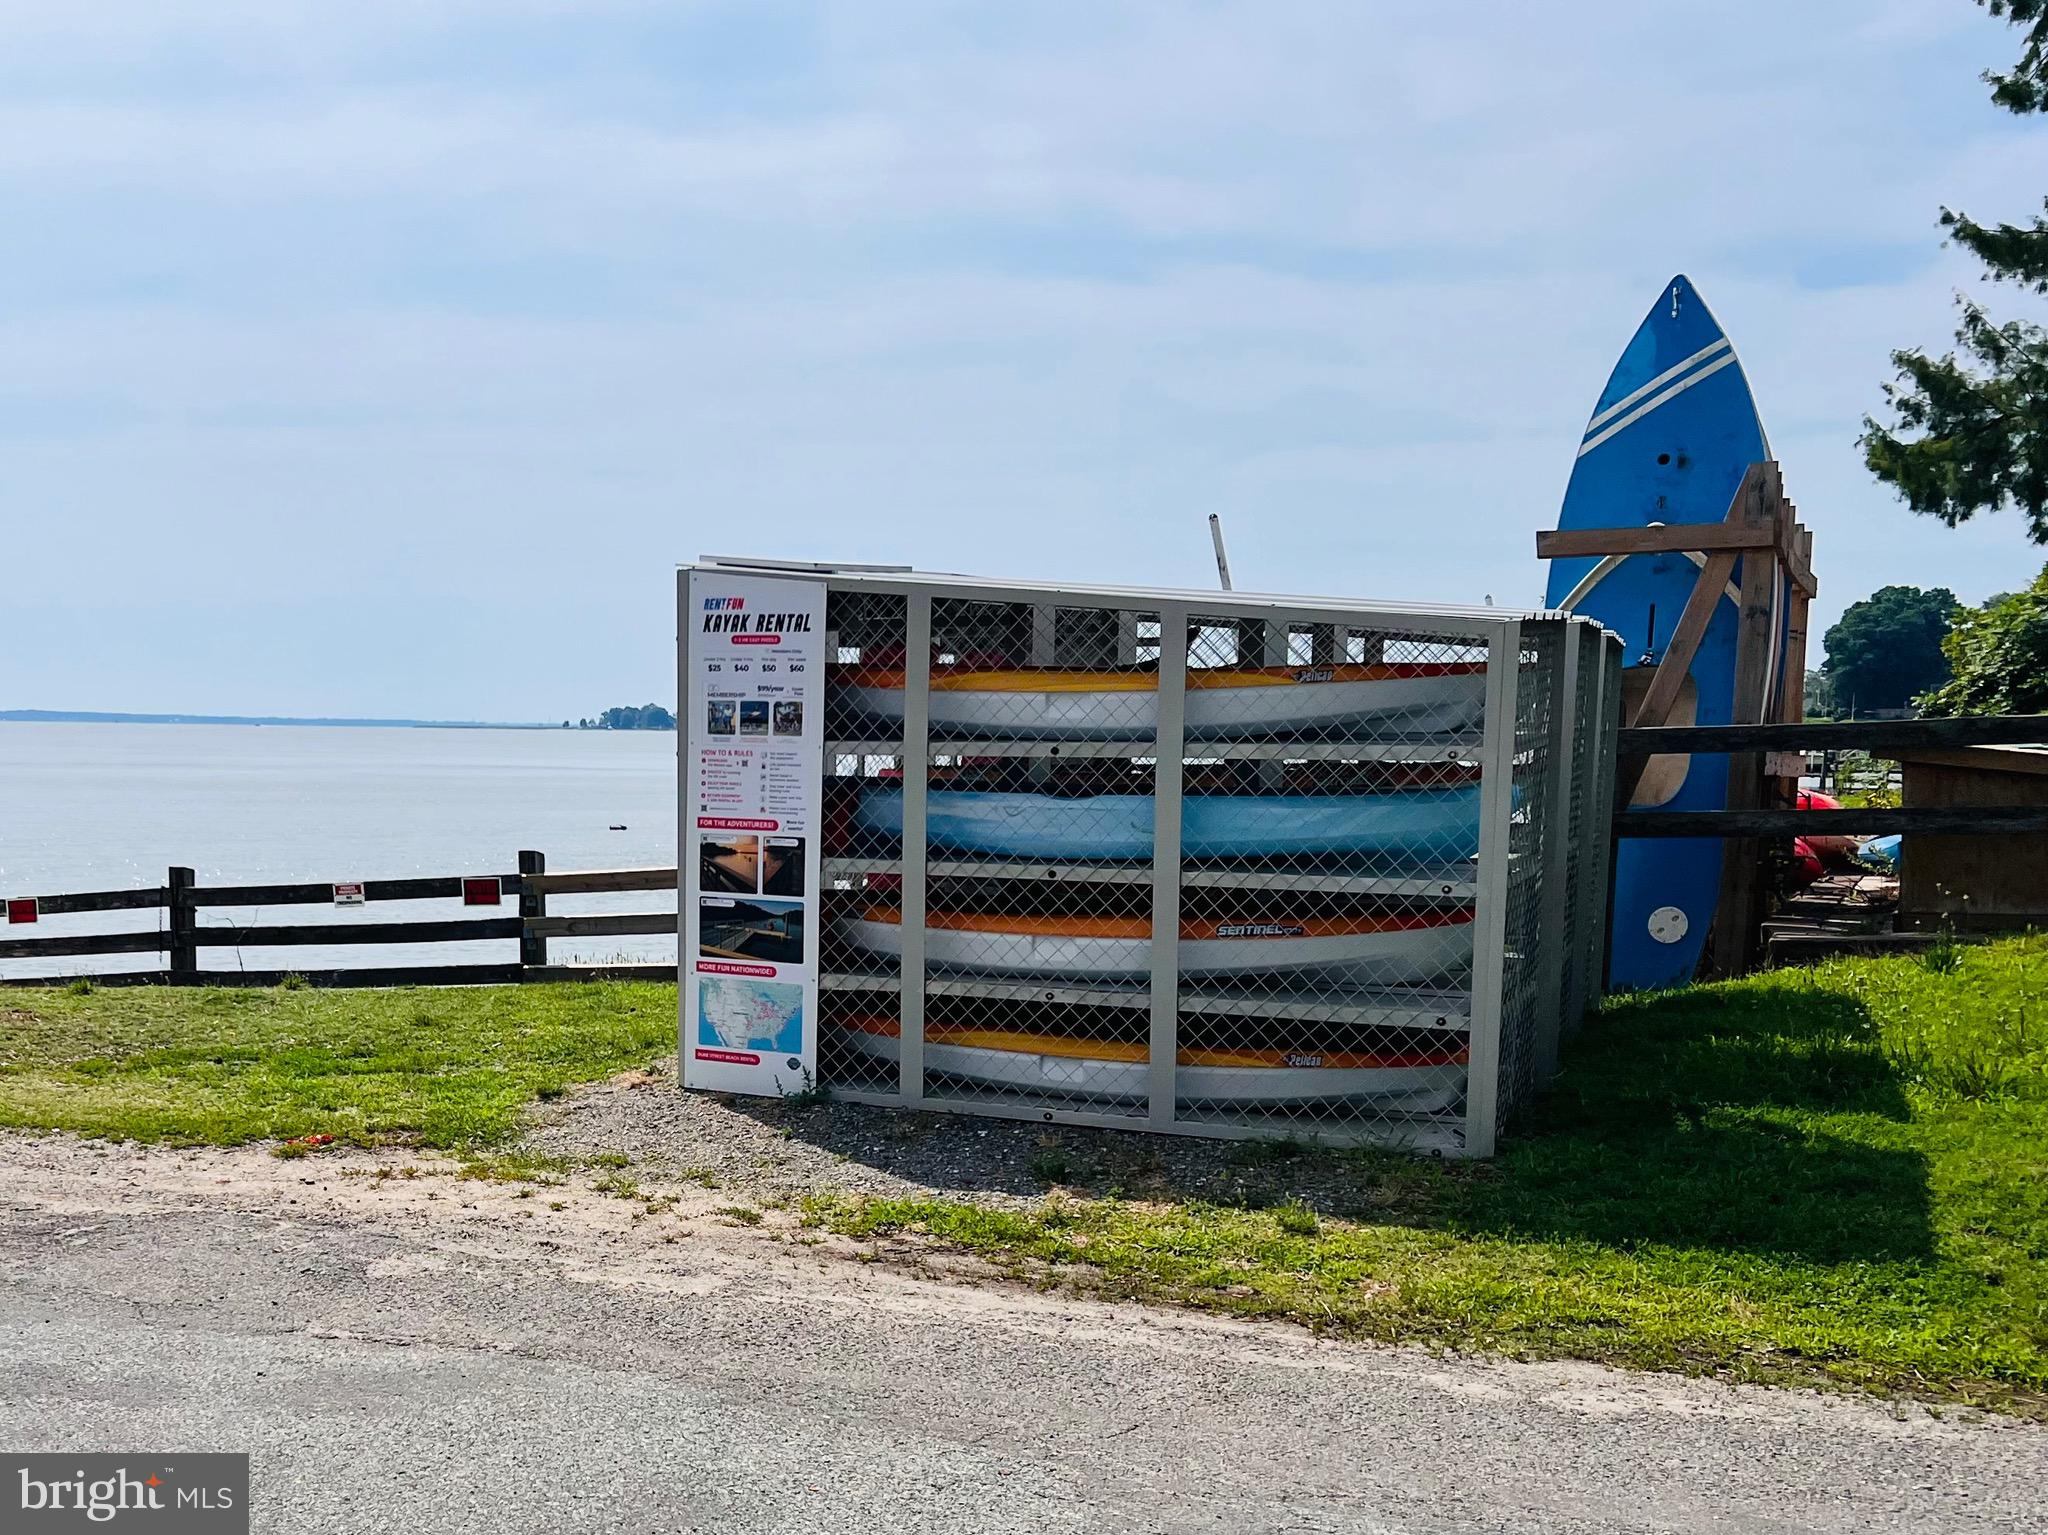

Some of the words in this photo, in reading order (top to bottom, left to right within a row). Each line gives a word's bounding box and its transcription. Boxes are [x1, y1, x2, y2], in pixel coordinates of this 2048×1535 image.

[703, 613, 751, 633] KAYAK
[756, 613, 811, 633] RENTAL
[708, 664, 721, 672] $25
[734, 664, 749, 672] $40
[762, 664, 776, 672] $50
[790, 664, 804, 672] $60
[714, 819, 726, 827] THE
[727, 820, 774, 829] ADVENTURERS!
[1218, 925, 1283, 936] SENTINEL
[698, 963, 716, 971] MORE
[717, 964, 729, 972] FUN
[731, 965, 772, 976] NATIONWIDE!
[1290, 1054, 1322, 1066] Pelican
